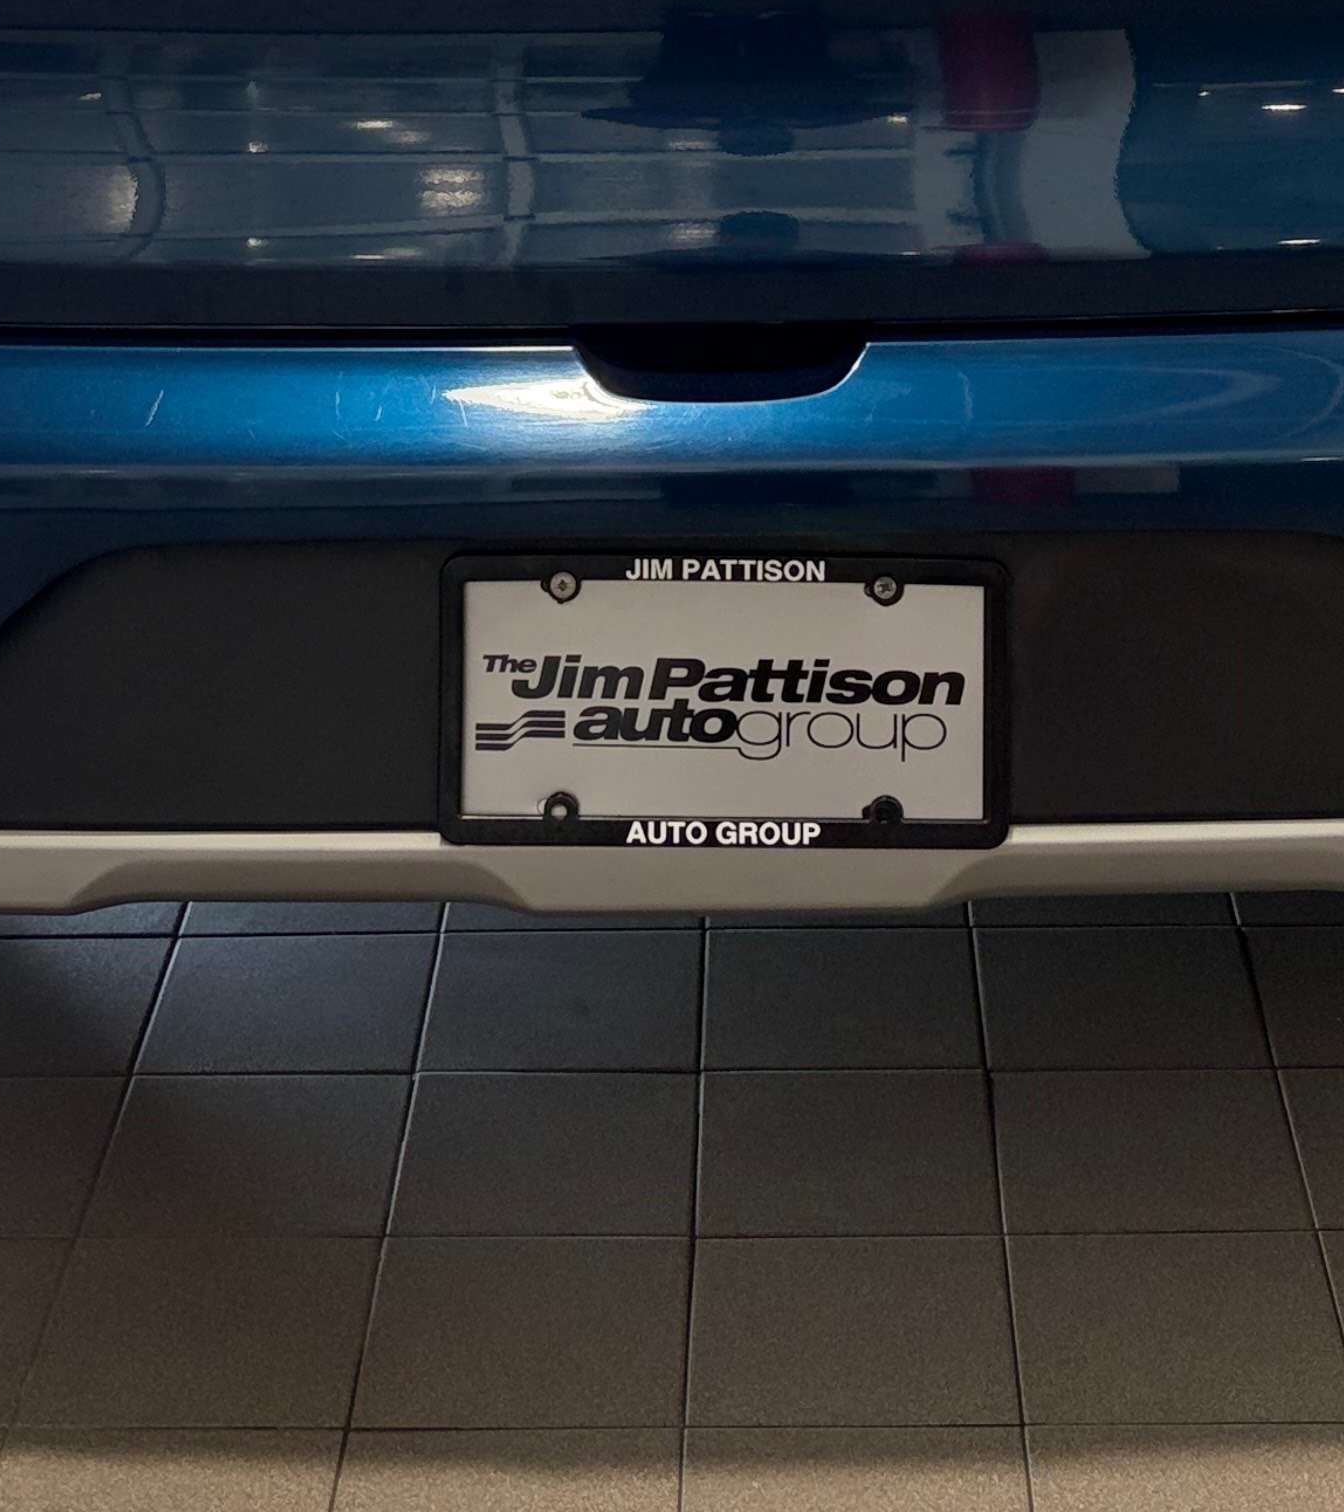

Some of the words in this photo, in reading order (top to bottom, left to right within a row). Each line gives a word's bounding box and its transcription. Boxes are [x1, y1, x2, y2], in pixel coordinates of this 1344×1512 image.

[625, 559, 674, 581] JIM
[682, 559, 827, 583] PATTISON
[482, 654, 537, 675] The
[511, 654, 644, 700] Jim
[647, 657, 966, 706] Pattison
[625, 821, 709, 845] AUTO
[715, 821, 822, 847] GROUP
